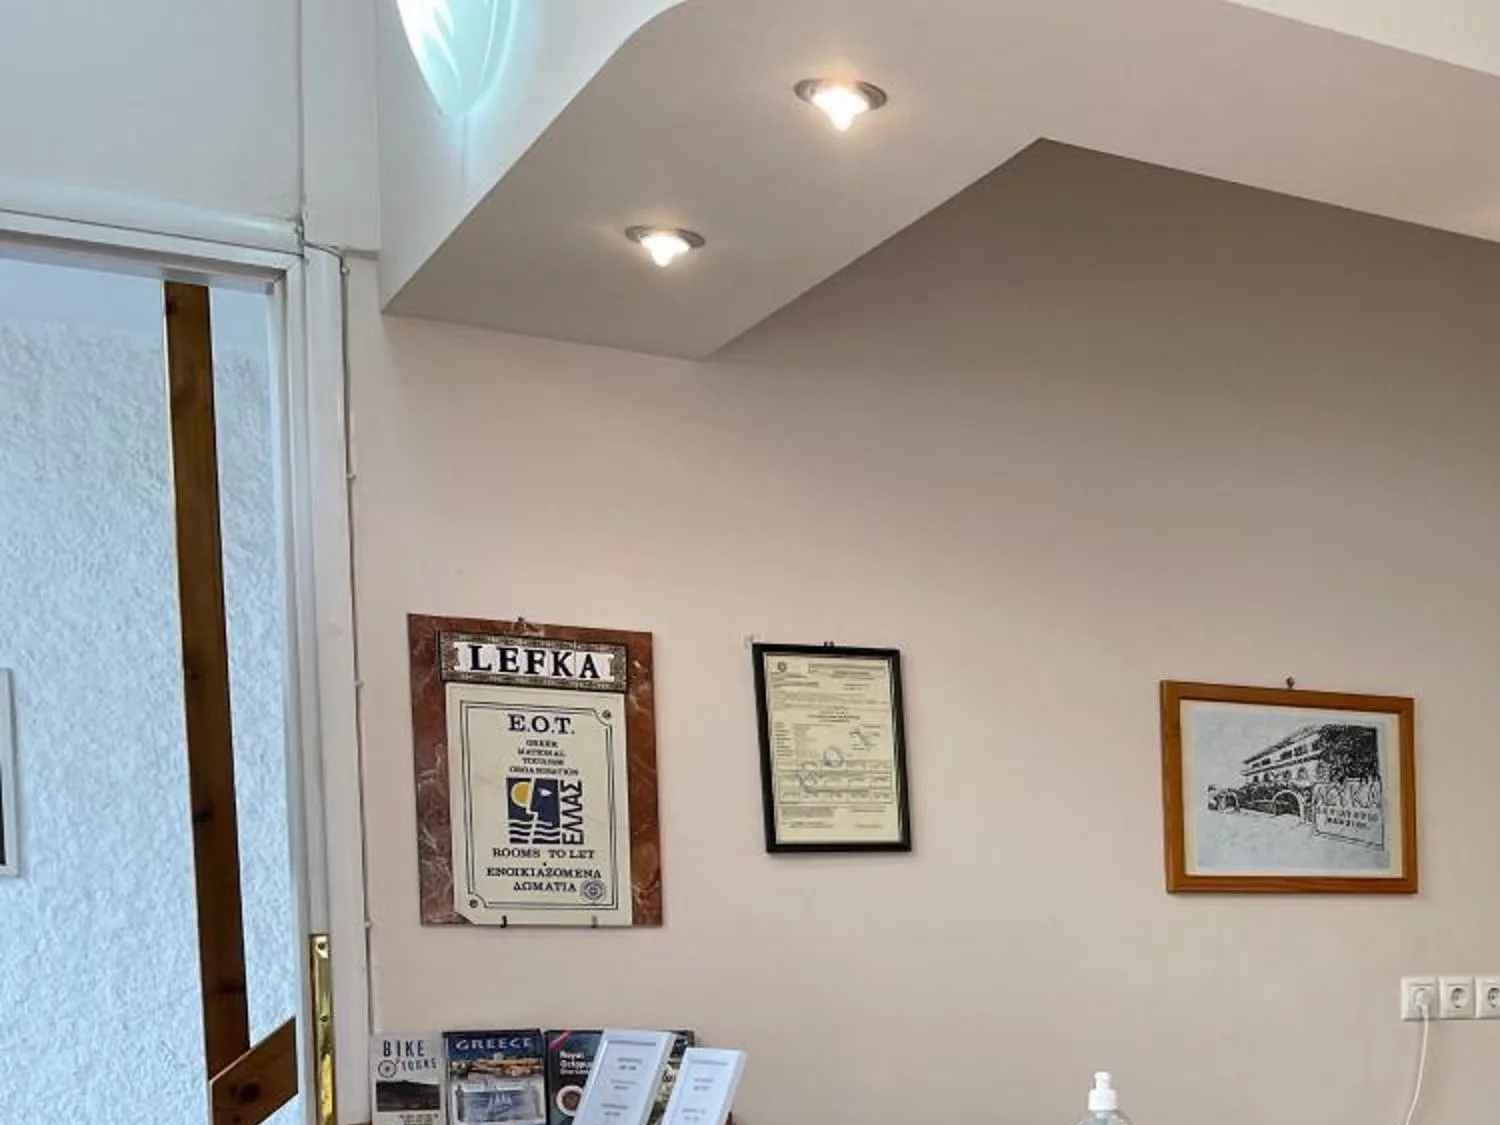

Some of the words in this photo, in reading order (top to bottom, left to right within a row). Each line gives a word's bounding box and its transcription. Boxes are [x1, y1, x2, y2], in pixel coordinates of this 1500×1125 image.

[468, 644, 601, 679] LEFKA
[492, 847, 541, 858] ROOMS
[548, 849, 566, 859] TO
[569, 850, 595, 859] LET
[383, 1040, 425, 1057] BIKE
[455, 1037, 533, 1051] GREECE
